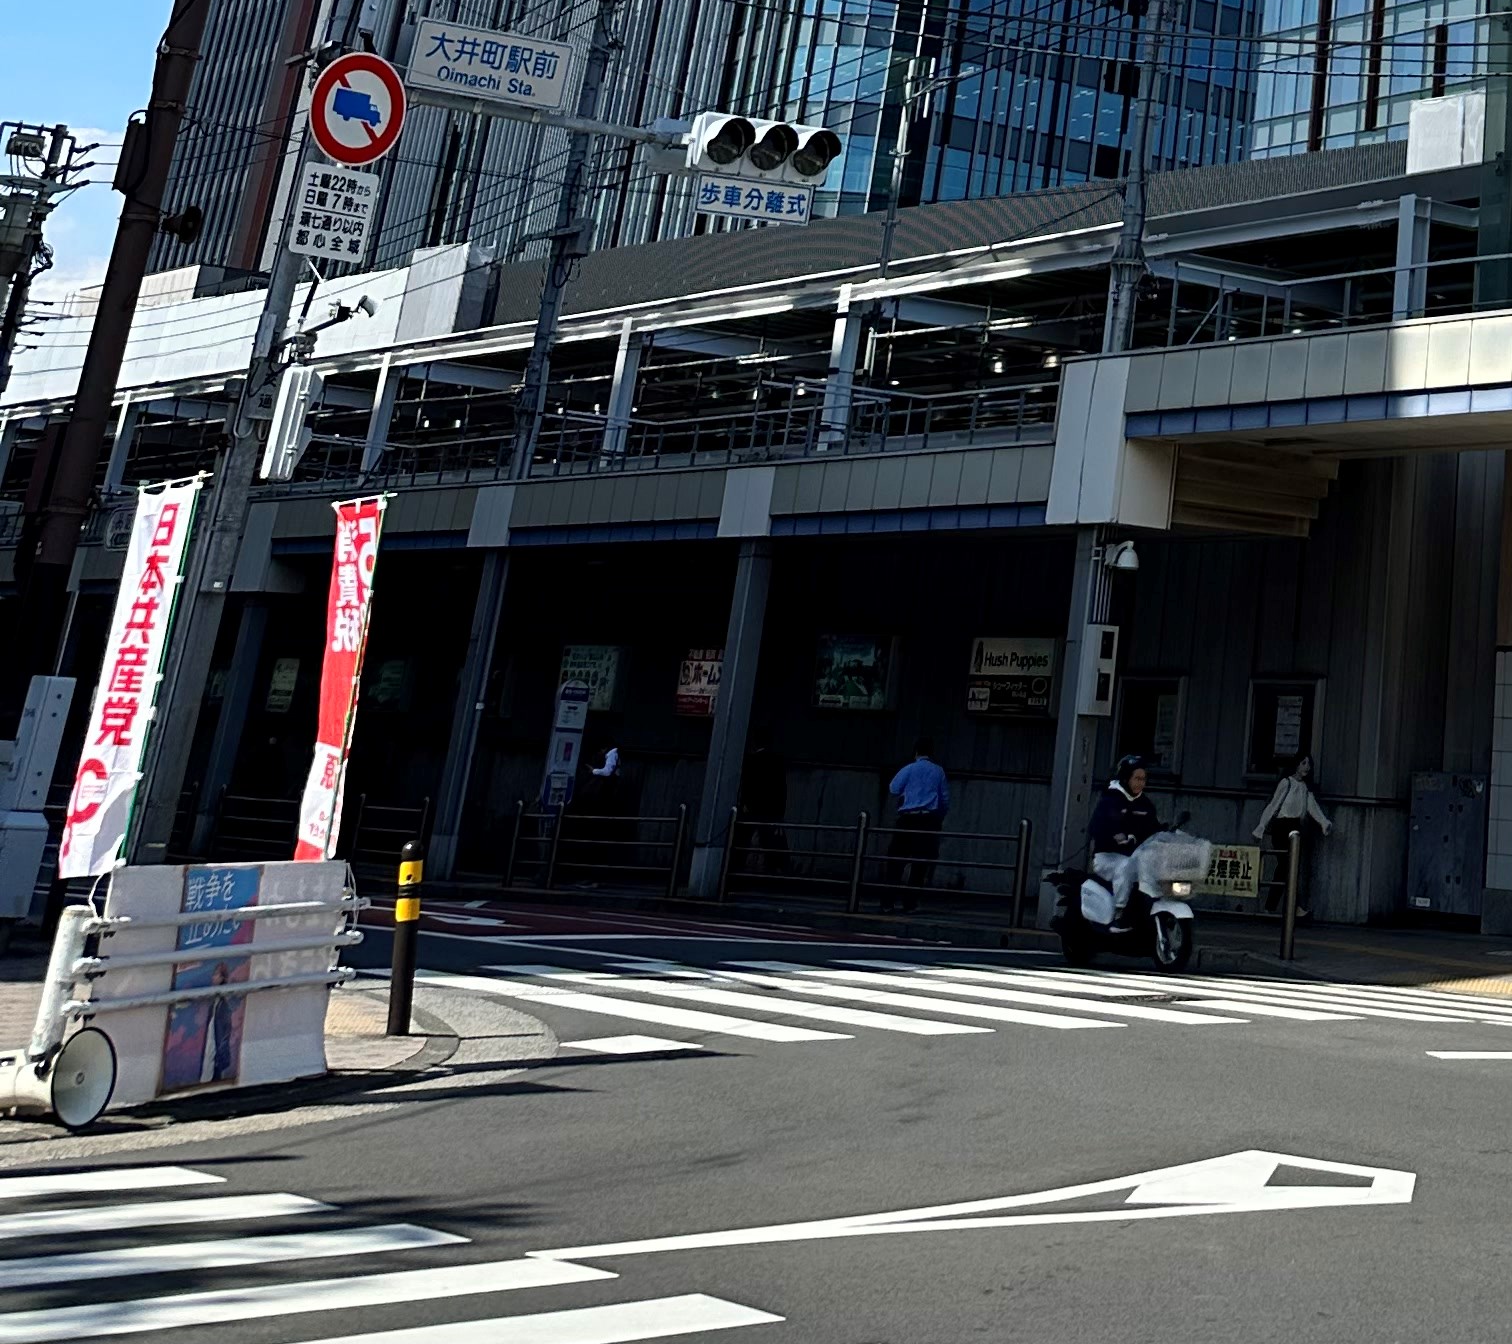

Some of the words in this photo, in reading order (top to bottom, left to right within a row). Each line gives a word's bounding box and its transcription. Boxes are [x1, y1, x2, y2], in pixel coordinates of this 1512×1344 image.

[425, 31, 560, 81] 大井町駅前
[437, 65, 501, 92] Oimachi
[507, 78, 536, 98] Sta.
[700, 181, 807, 216] 歩車分離式
[94, 502, 181, 746] 日本共産党
[984, 651, 1009, 667] Hush
[1010, 651, 1049, 672] Puppies
